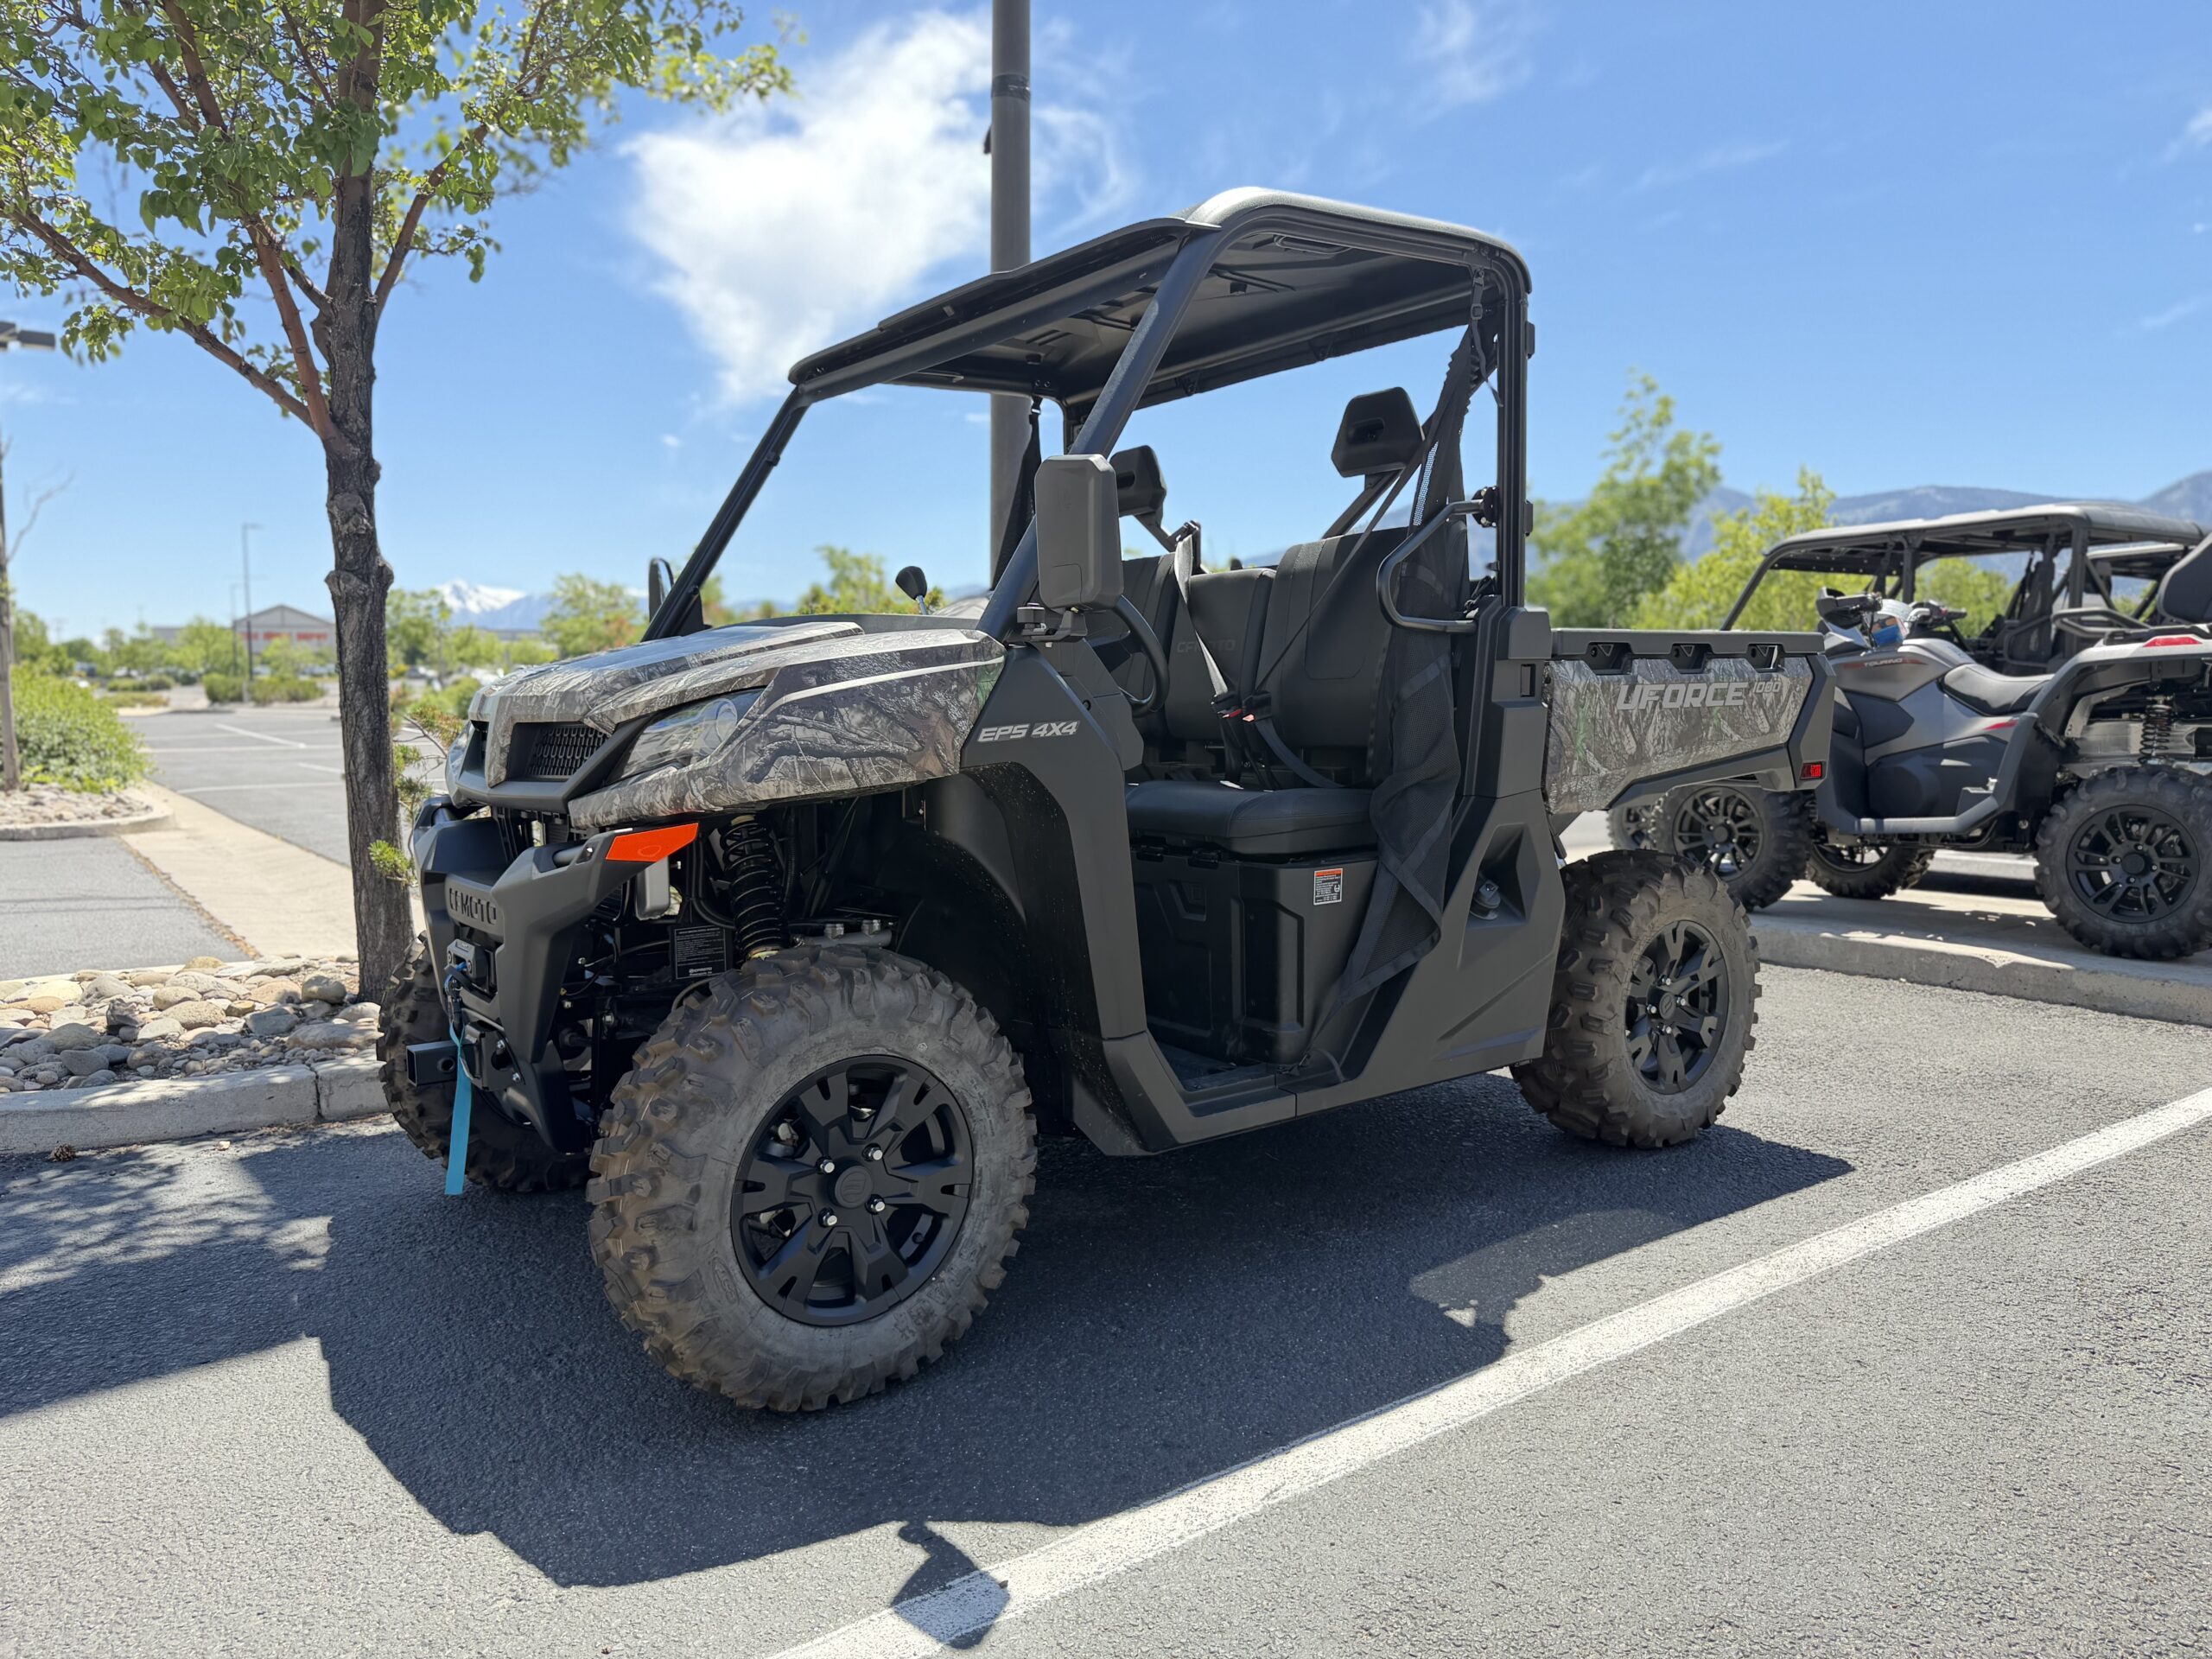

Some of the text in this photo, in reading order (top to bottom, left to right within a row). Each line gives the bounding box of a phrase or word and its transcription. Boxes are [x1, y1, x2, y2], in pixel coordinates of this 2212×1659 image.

[1617, 681, 1781, 710] UFORCE 1000
[977, 721, 1078, 742] EPS 4X4
[448, 887, 497, 925] CFMOTO
